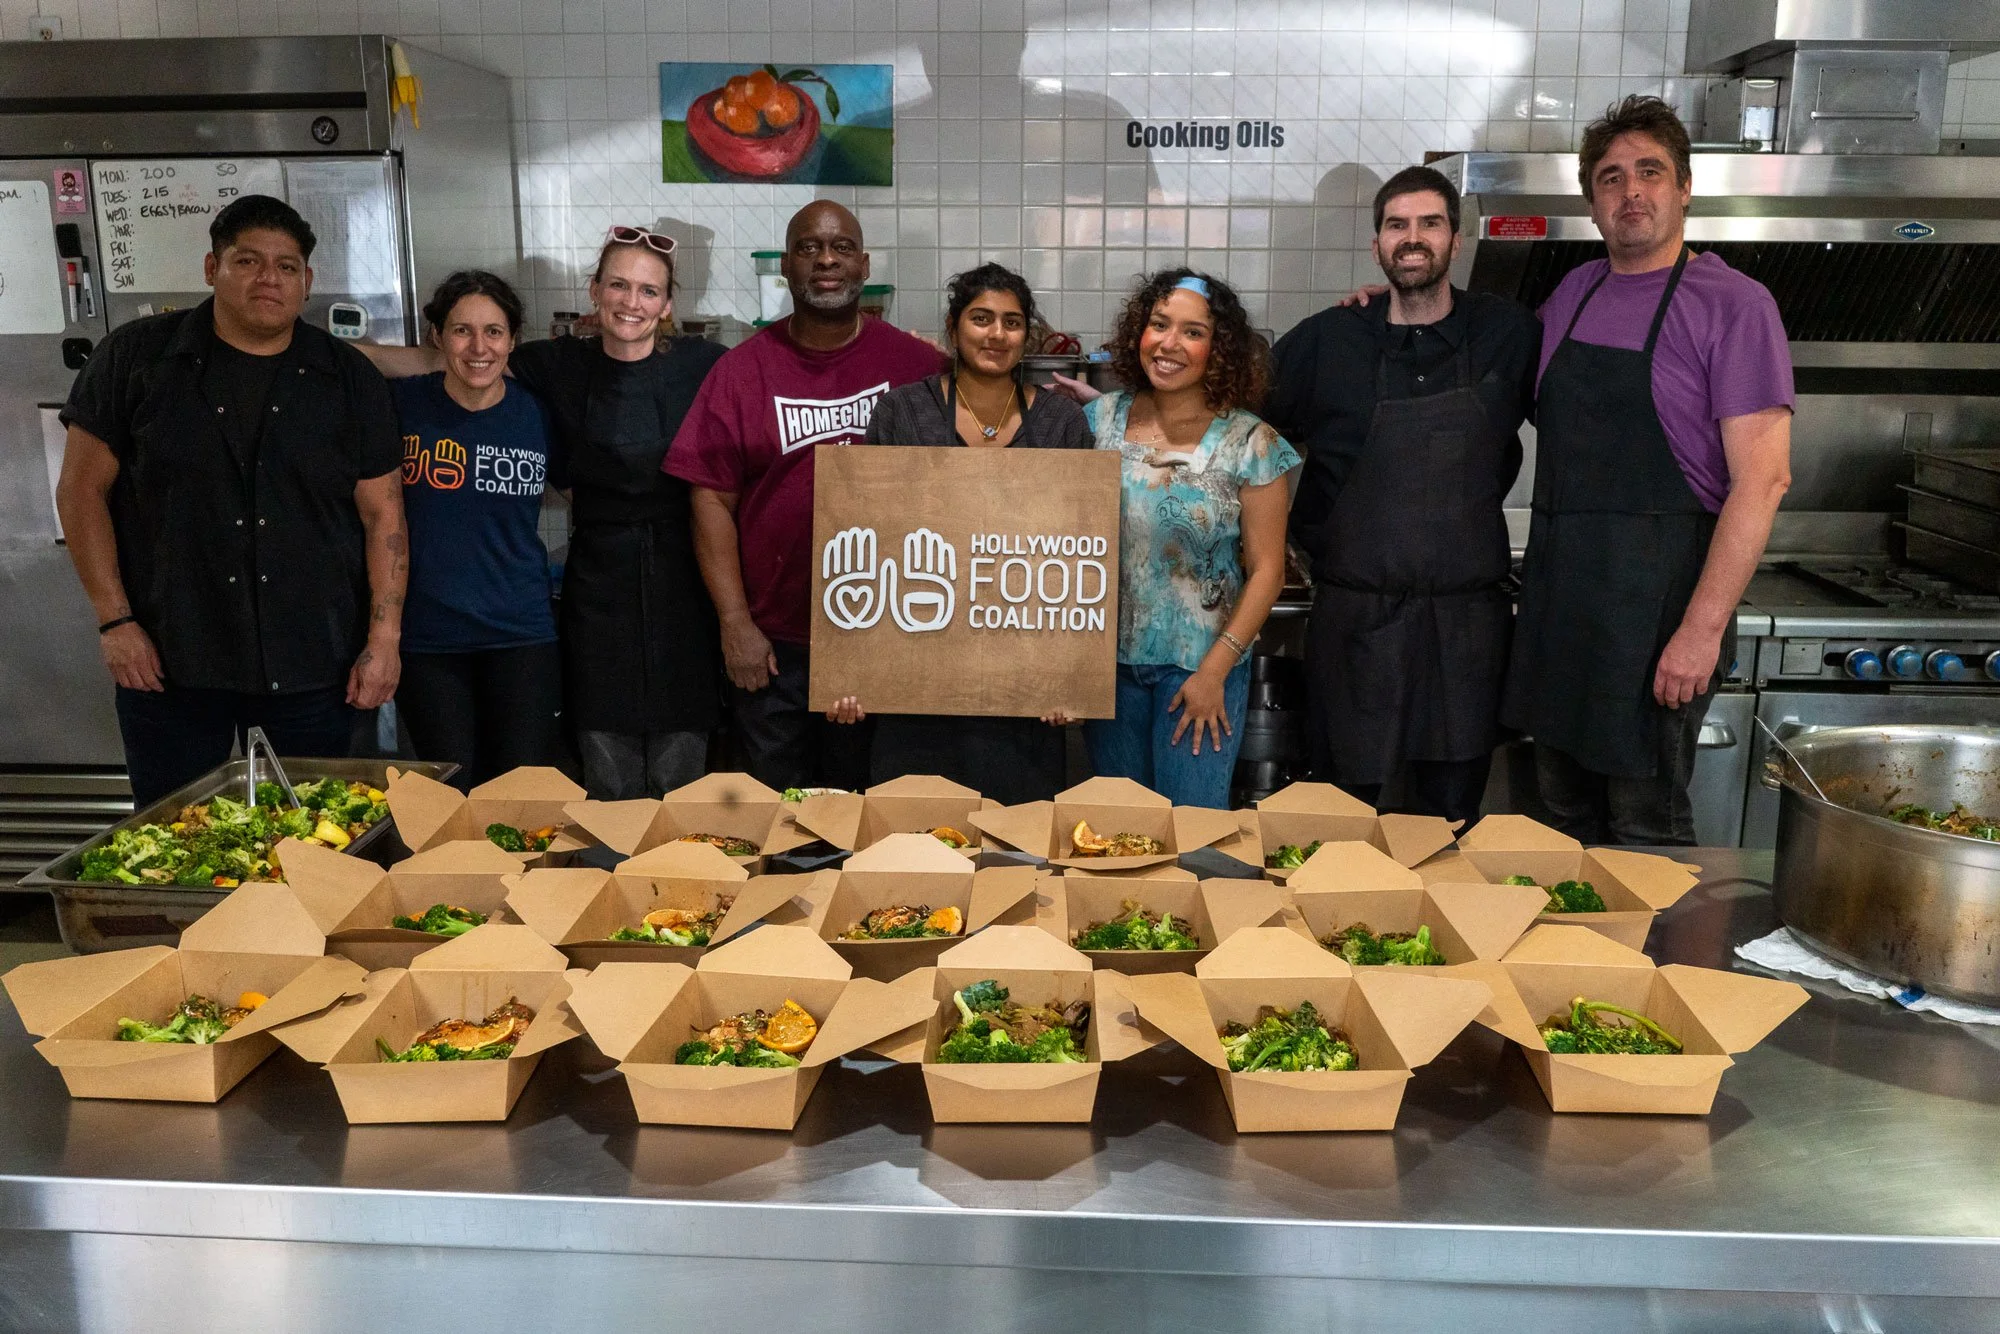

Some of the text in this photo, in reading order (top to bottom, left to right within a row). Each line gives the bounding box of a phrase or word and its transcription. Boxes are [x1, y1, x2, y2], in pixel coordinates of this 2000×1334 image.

[1127, 121, 1285, 151] Cooking Oils
[140, 166, 176, 180] 200
[142, 186, 170, 200] 215
[218, 187, 239, 198] 50
[113, 272, 135, 288] SUN
[476, 444, 546, 465] HOLLYWOOD
[475, 455, 546, 482] FOOD
[475, 479, 545, 496] COALITION
[971, 533, 1107, 557] HOLLYWOOD
[969, 557, 1107, 604] FOOD
[968, 604, 1105, 631] COALITION
